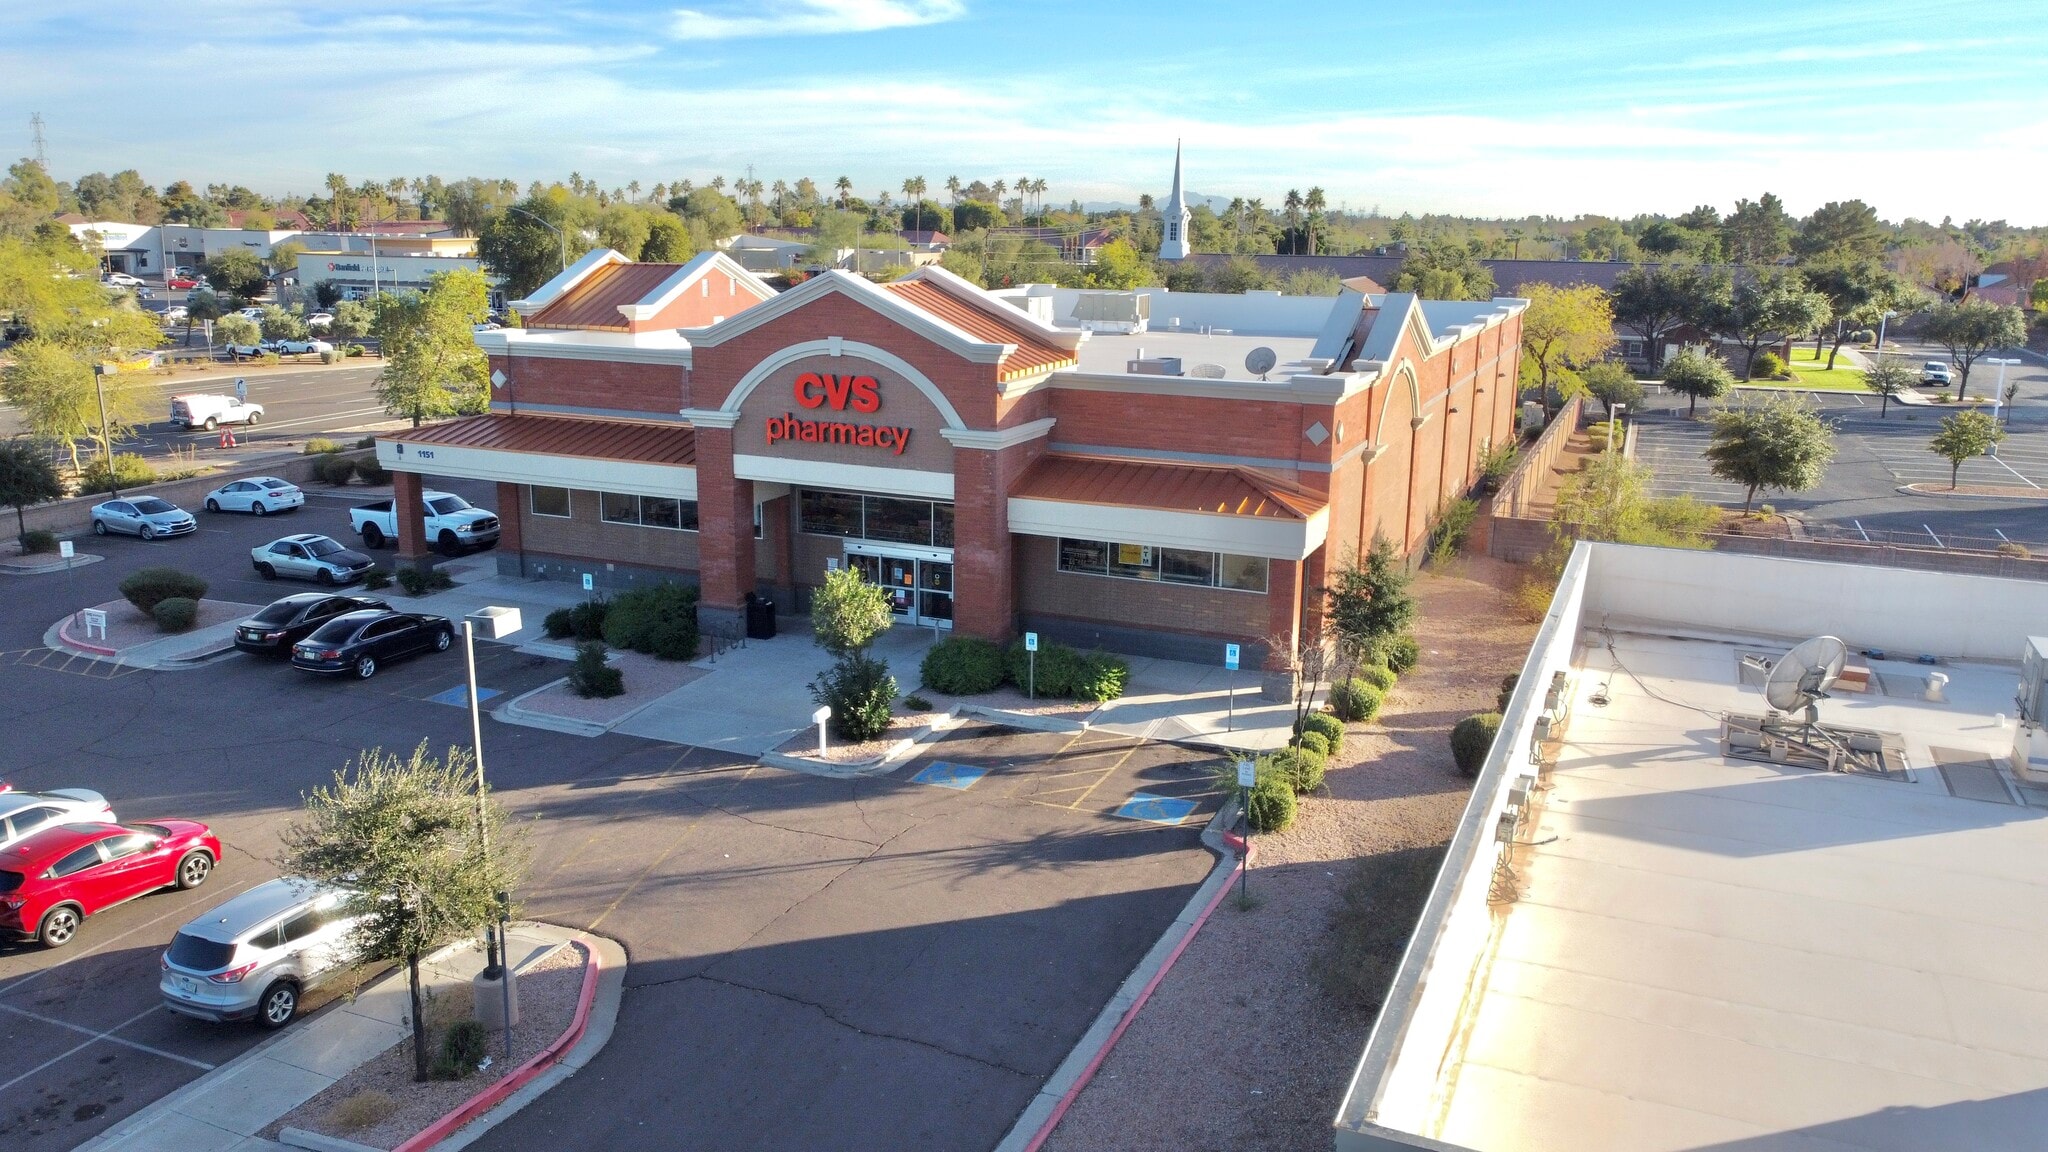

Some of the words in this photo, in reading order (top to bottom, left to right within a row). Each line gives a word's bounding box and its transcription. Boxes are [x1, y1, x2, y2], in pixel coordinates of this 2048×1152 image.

[794, 372, 880, 413] CVS
[418, 450, 434, 459] 1151
[766, 412, 911, 456] pharmacy
